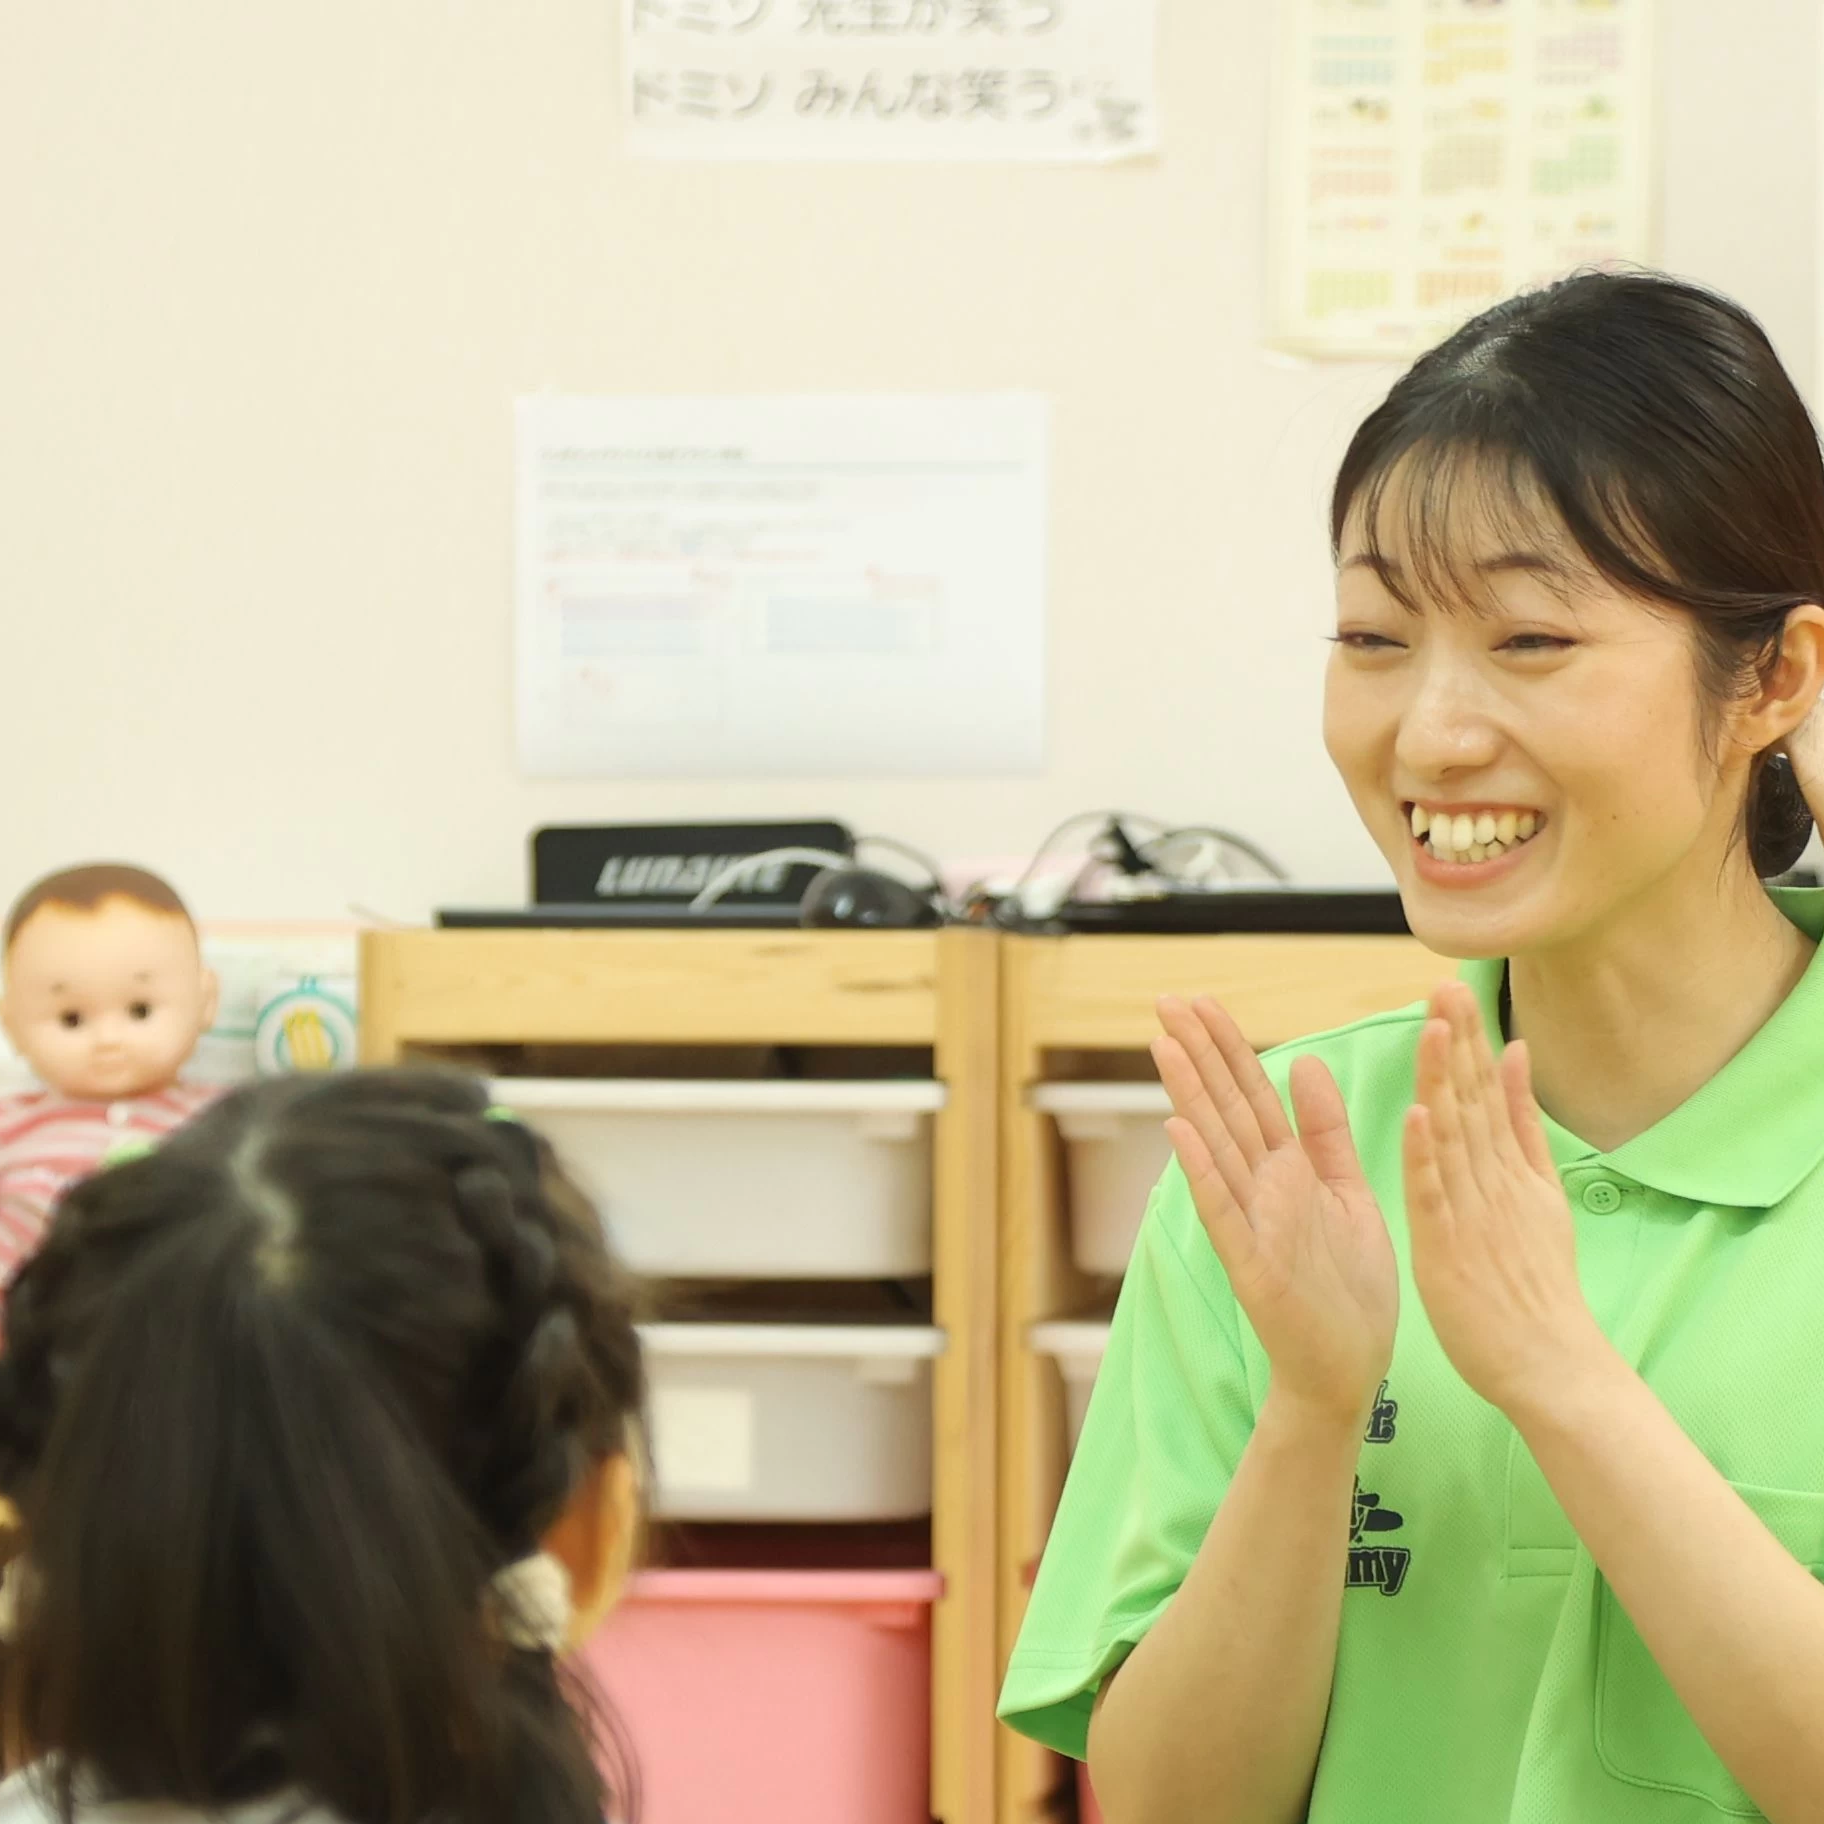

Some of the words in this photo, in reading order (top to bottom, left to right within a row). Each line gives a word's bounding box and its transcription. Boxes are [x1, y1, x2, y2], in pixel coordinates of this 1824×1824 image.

[793, 66, 1067, 122] みんな笑う
[1346, 1546, 1411, 1596] my
